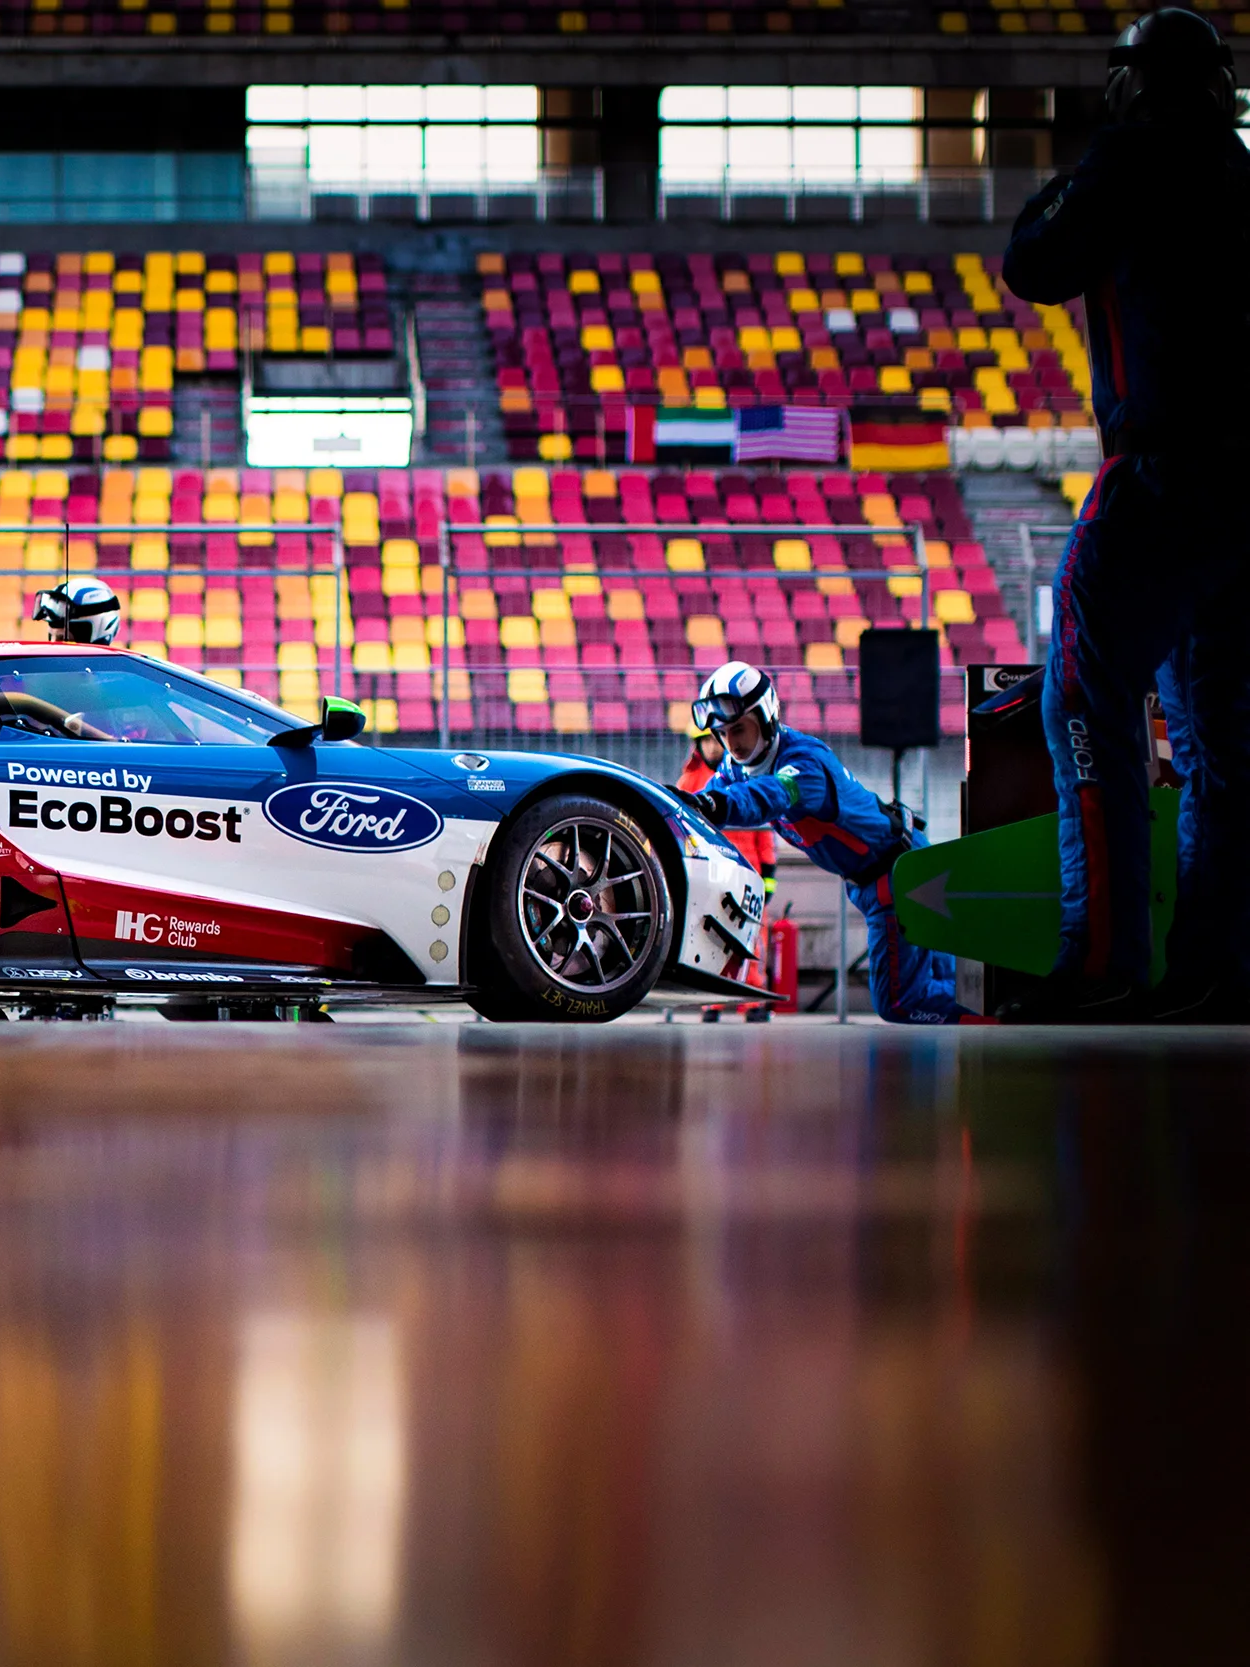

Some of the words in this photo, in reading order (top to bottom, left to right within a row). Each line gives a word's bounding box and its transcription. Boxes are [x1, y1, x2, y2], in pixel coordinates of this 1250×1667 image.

[1067, 718, 1099, 783] FORD
[7, 762, 117, 787] Powered
[123, 767, 152, 793] by
[9, 789, 242, 843] EcoBoost
[300, 788, 408, 842] Ford
[115, 910, 163, 944] IHG
[169, 915, 221, 935] Rewards
[167, 932, 197, 948] Club
[148, 969, 245, 983] brembo
[540, 987, 567, 1007] SET
[566, 996, 610, 1016] TRAVEL
